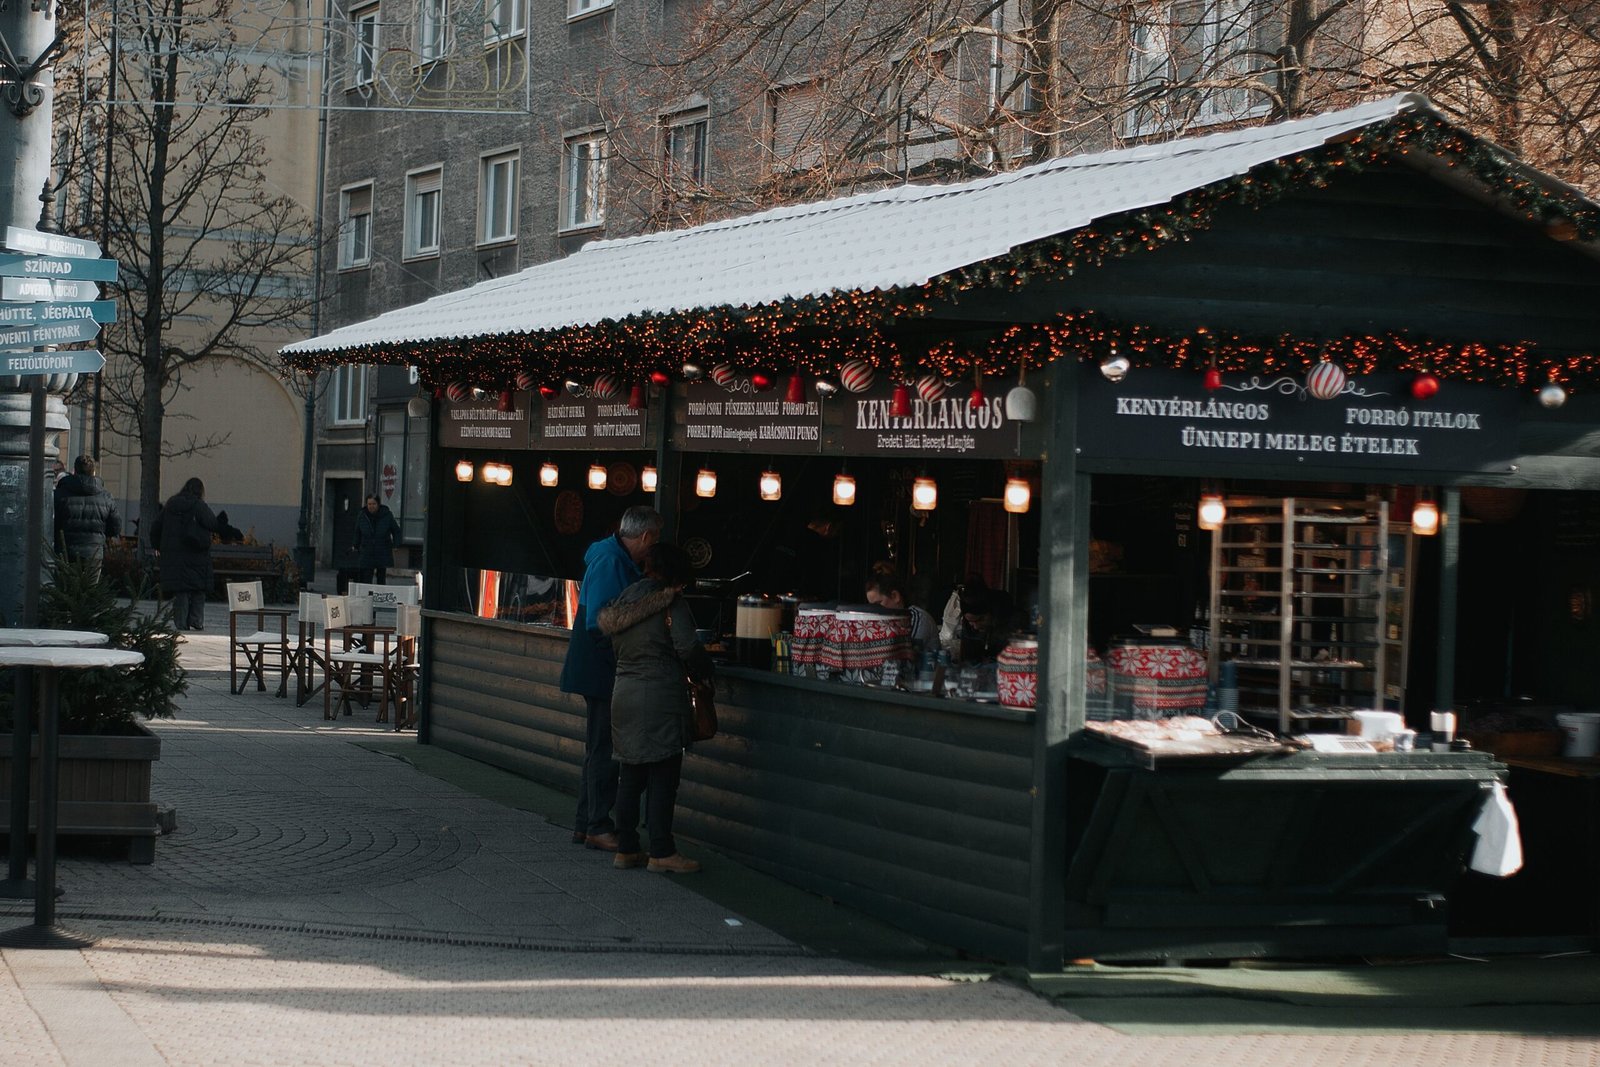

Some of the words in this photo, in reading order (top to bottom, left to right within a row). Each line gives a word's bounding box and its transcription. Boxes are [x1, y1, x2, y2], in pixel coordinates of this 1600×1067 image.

[49, 237, 86, 256] KÖRHINTA
[25, 259, 72, 274] SZÍNPAD
[41, 305, 94, 319] JÉGPÁLYA
[33, 324, 80, 341] FÉNYPARK
[8, 355, 74, 370] FELTÖLTŐPONT
[1116, 396, 1269, 421] KENYÉRLÁNGOS
[1345, 405, 1409, 427] FORRÓ
[1412, 409, 1481, 430] ITALOK
[759, 422, 796, 440] KARÁCSONYI
[796, 426, 819, 440] PUNCS
[877, 434, 903, 449] Eredeti
[904, 434, 920, 449] Házi
[922, 434, 946, 452] Recept
[946, 434, 976, 453] Alapján
[1181, 426, 1261, 449] ÜNNEPI
[1264, 433, 1336, 453] MELEG
[1340, 433, 1419, 456] ÉTELEK
